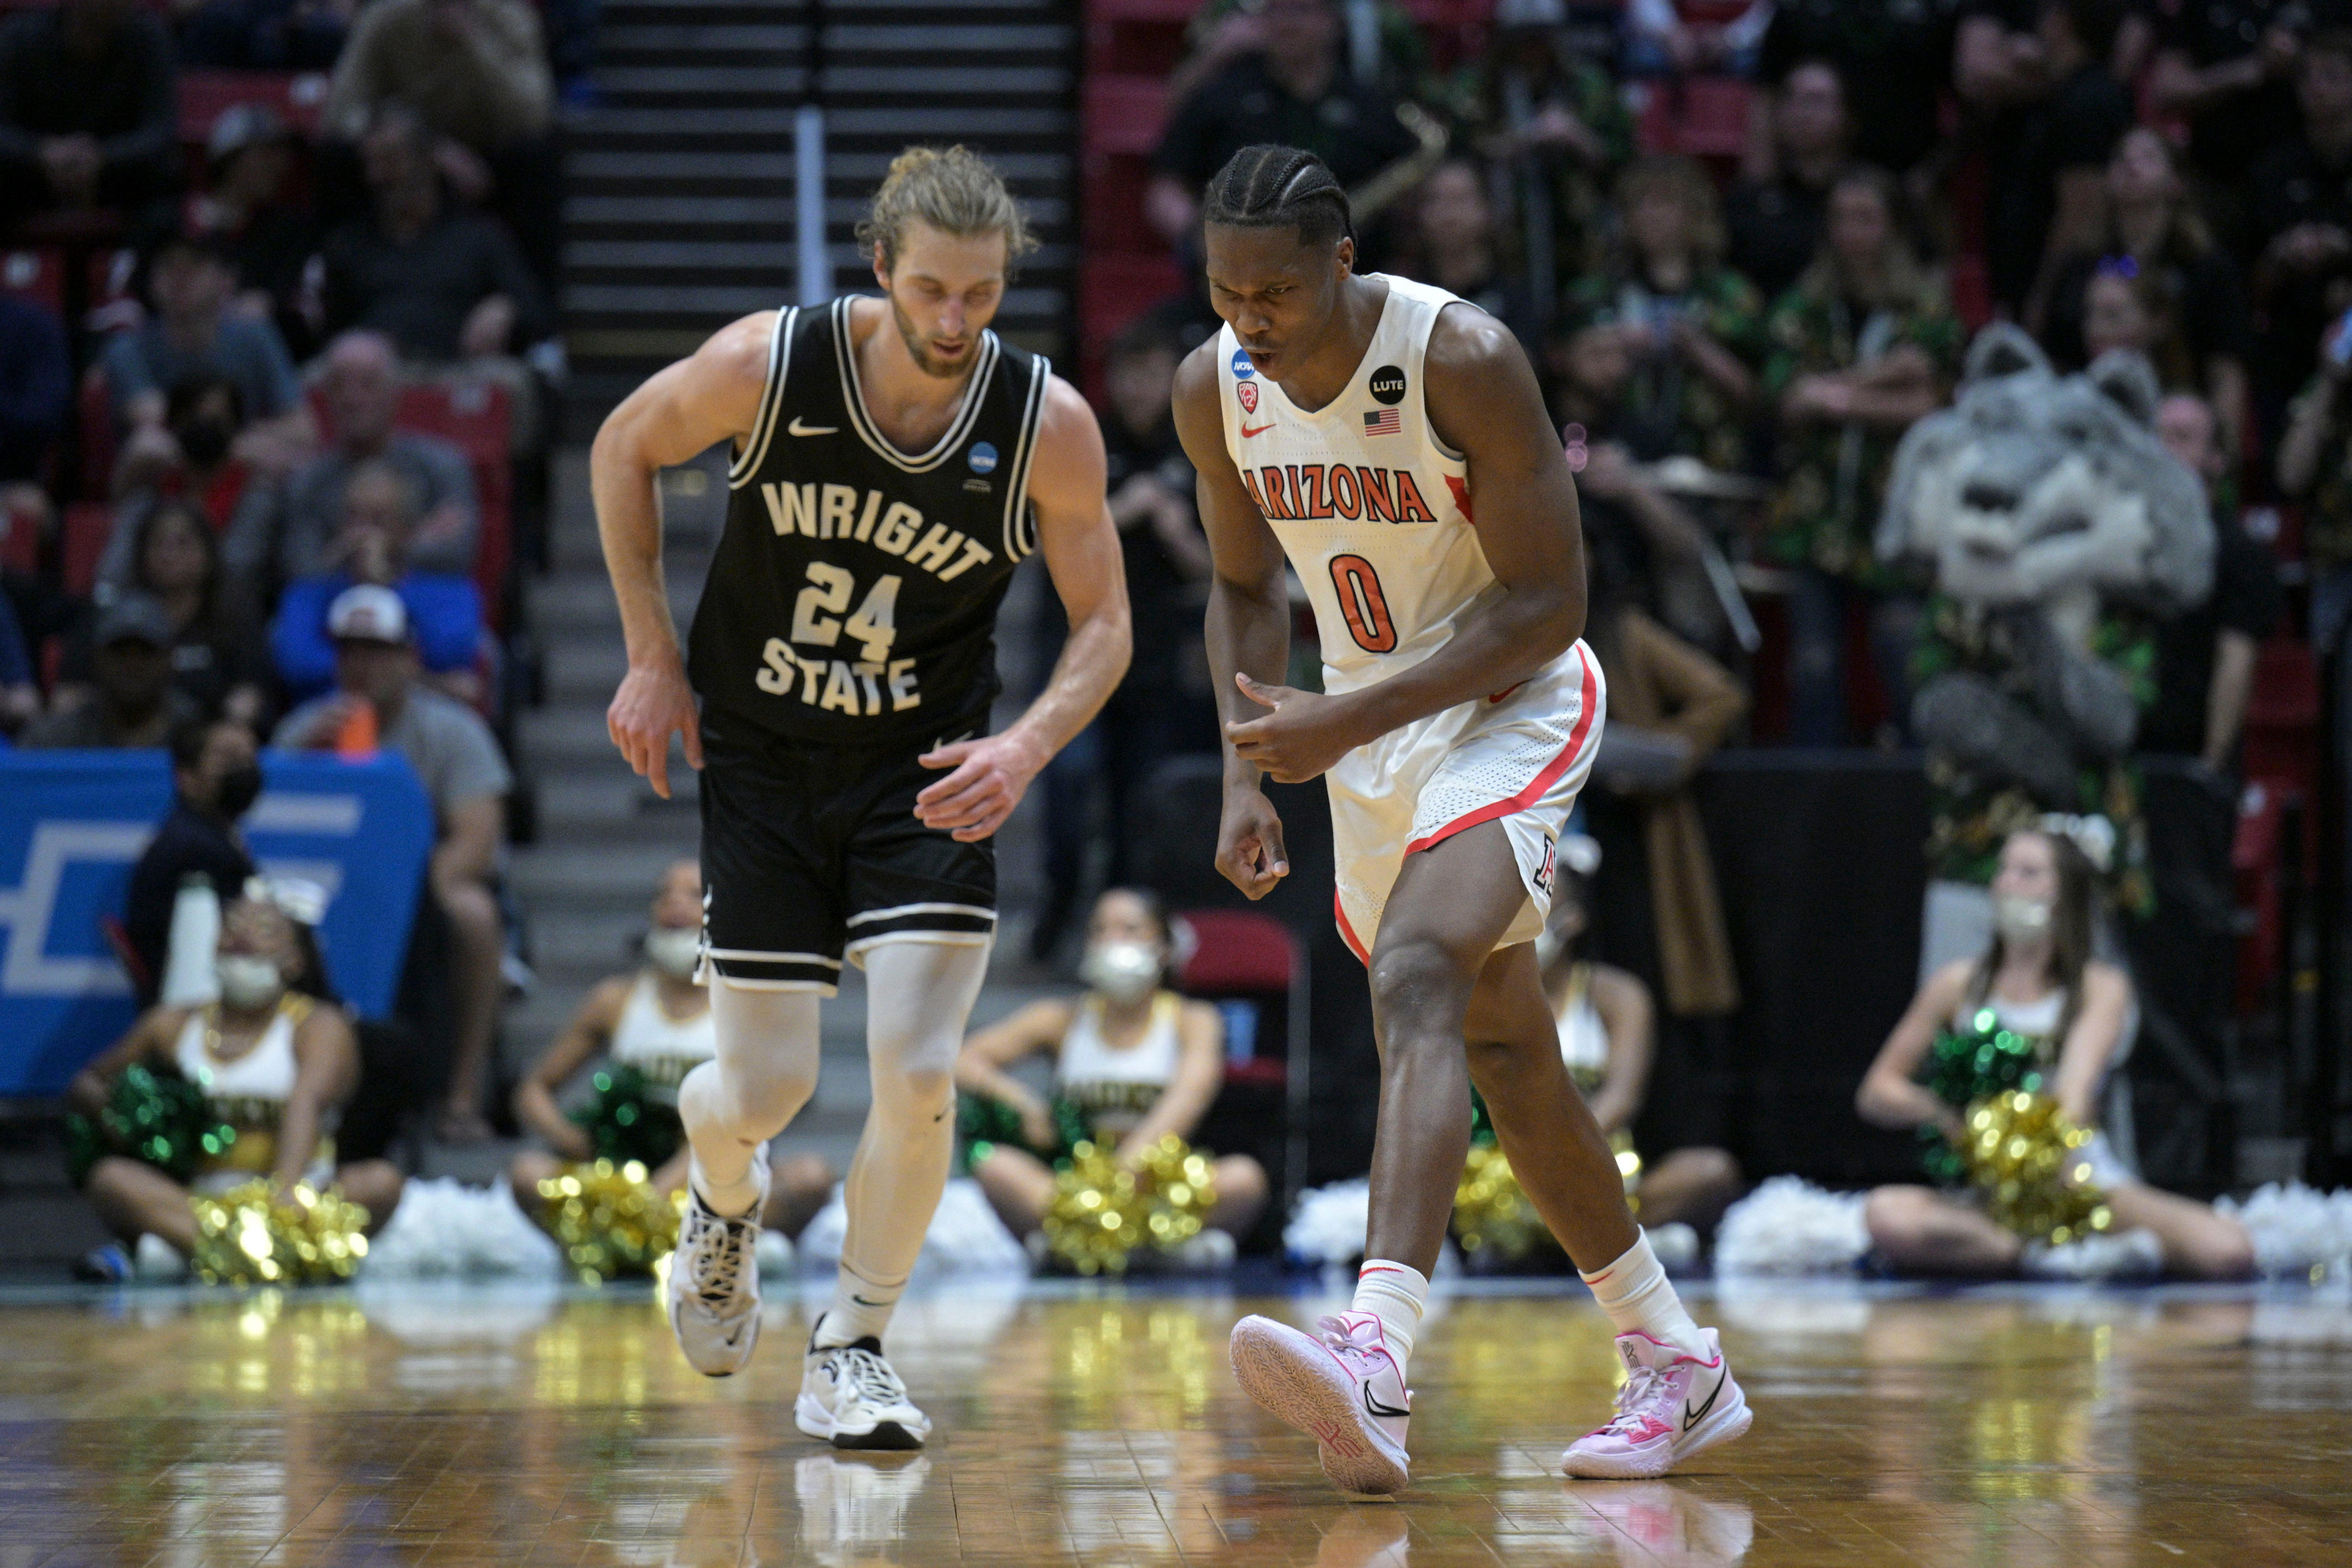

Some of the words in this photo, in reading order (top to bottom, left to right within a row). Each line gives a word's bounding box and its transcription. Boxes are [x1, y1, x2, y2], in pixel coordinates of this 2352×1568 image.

[1244, 394, 1254, 407] 12
[1373, 380, 1404, 392] LUTE
[761, 481, 993, 582] WRIGHT
[1242, 464, 1438, 524] ARIZONA
[790, 561, 903, 662] 24
[1329, 554, 1397, 653] 0
[755, 637, 921, 716] STATE
